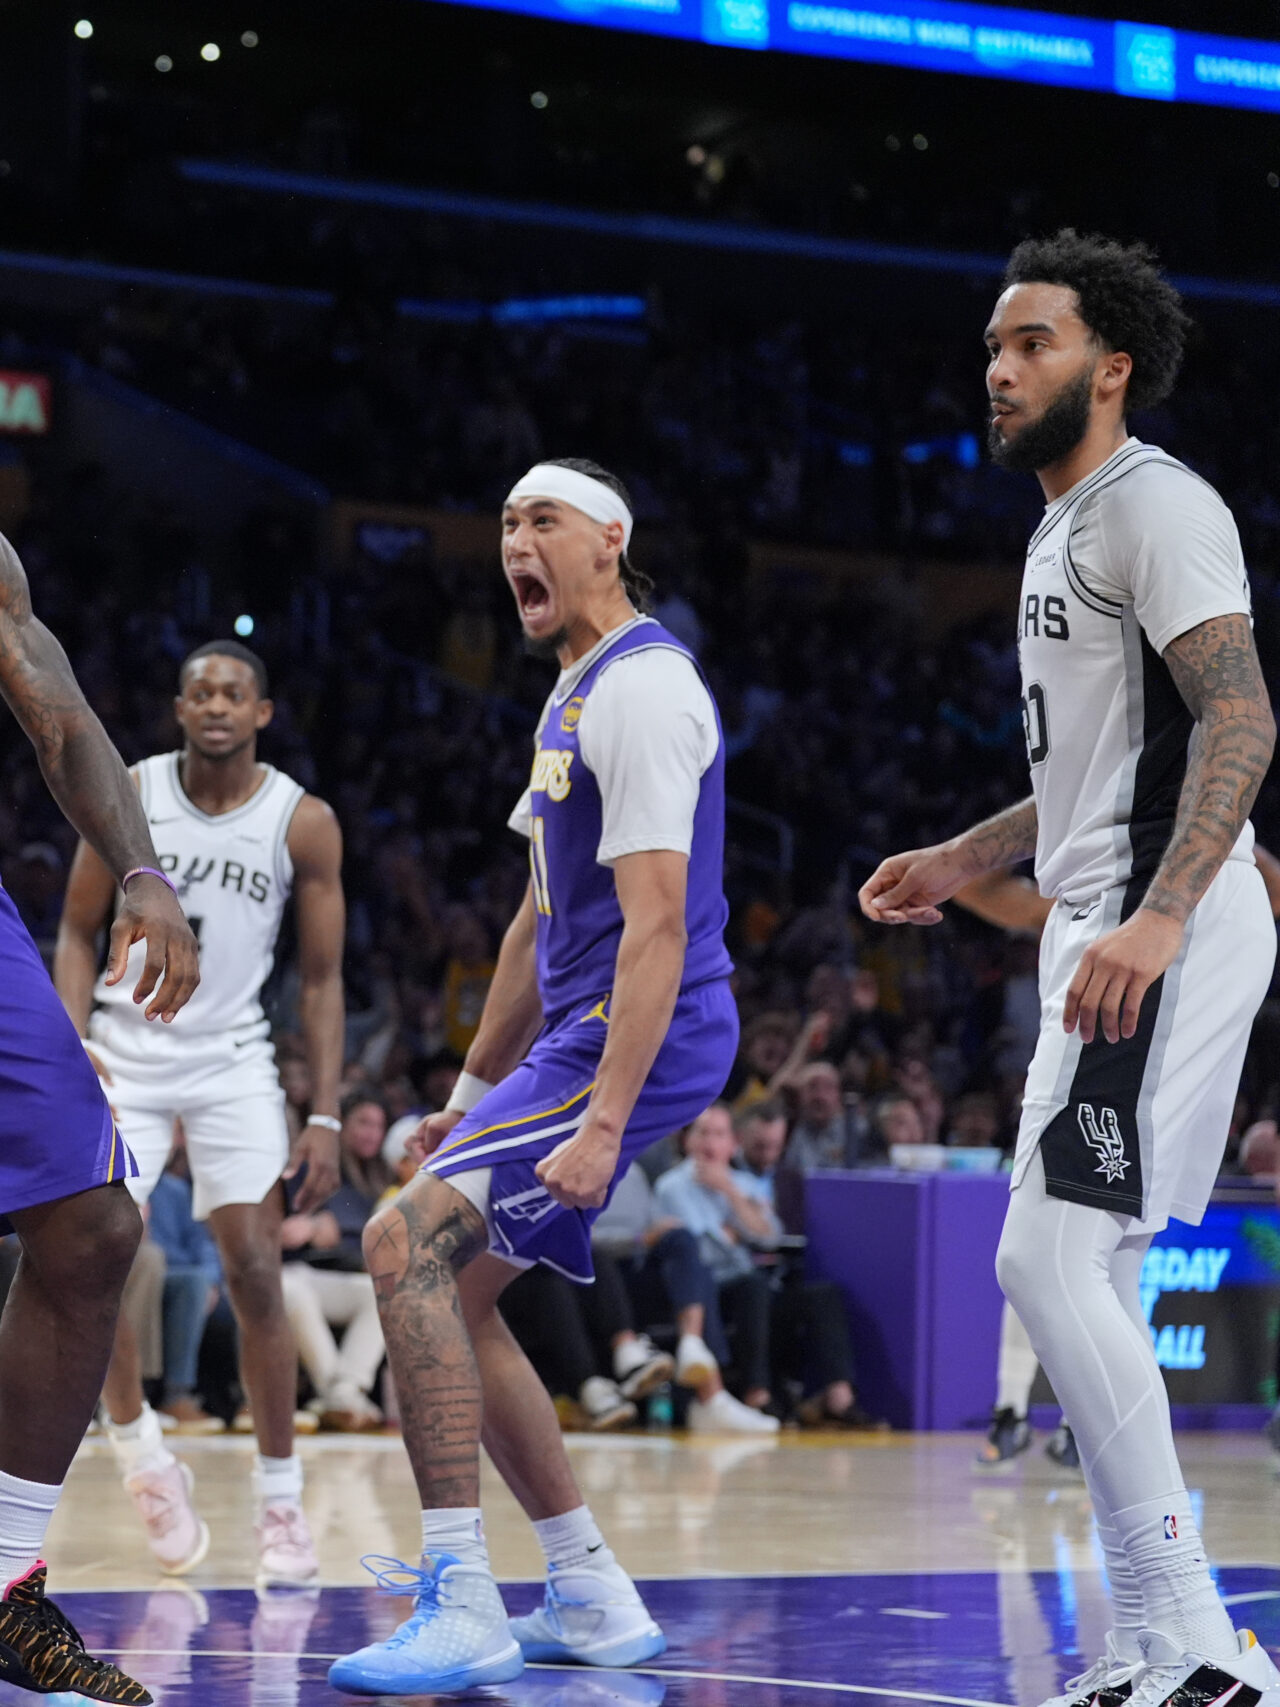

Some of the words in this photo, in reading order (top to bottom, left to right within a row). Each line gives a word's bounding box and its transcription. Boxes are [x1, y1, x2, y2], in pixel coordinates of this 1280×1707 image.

[1021, 594, 1069, 641] RS
[1022, 680, 1051, 767] 0
[1139, 1246, 1232, 1292] SDAY
